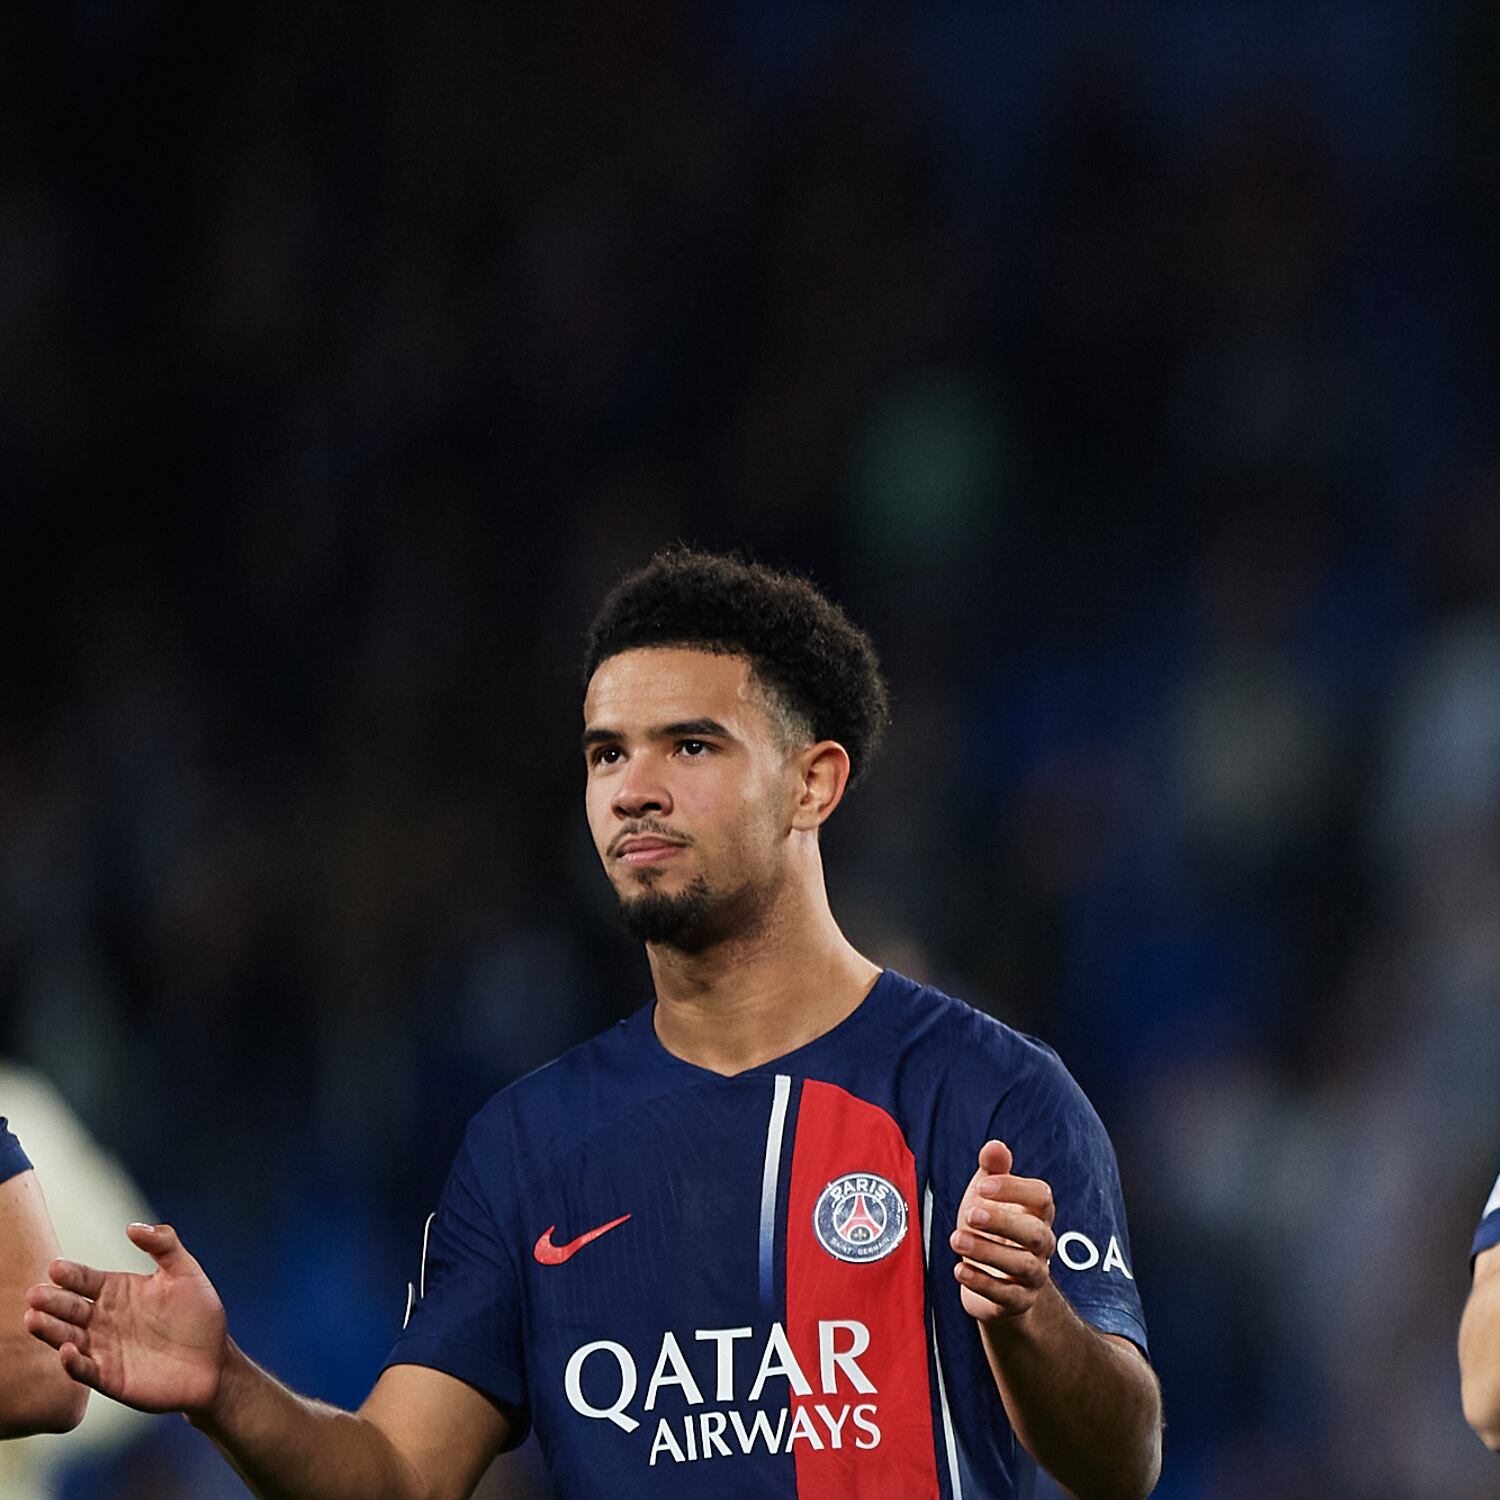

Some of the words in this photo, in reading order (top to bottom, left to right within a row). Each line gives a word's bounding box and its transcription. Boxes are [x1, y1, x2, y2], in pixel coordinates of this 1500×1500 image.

[830, 1178, 889, 1201] PARIS
[1047, 1231, 1133, 1280] OA
[564, 1320, 877, 1432] QATAR
[649, 1404, 881, 1466] AIRWAYS
